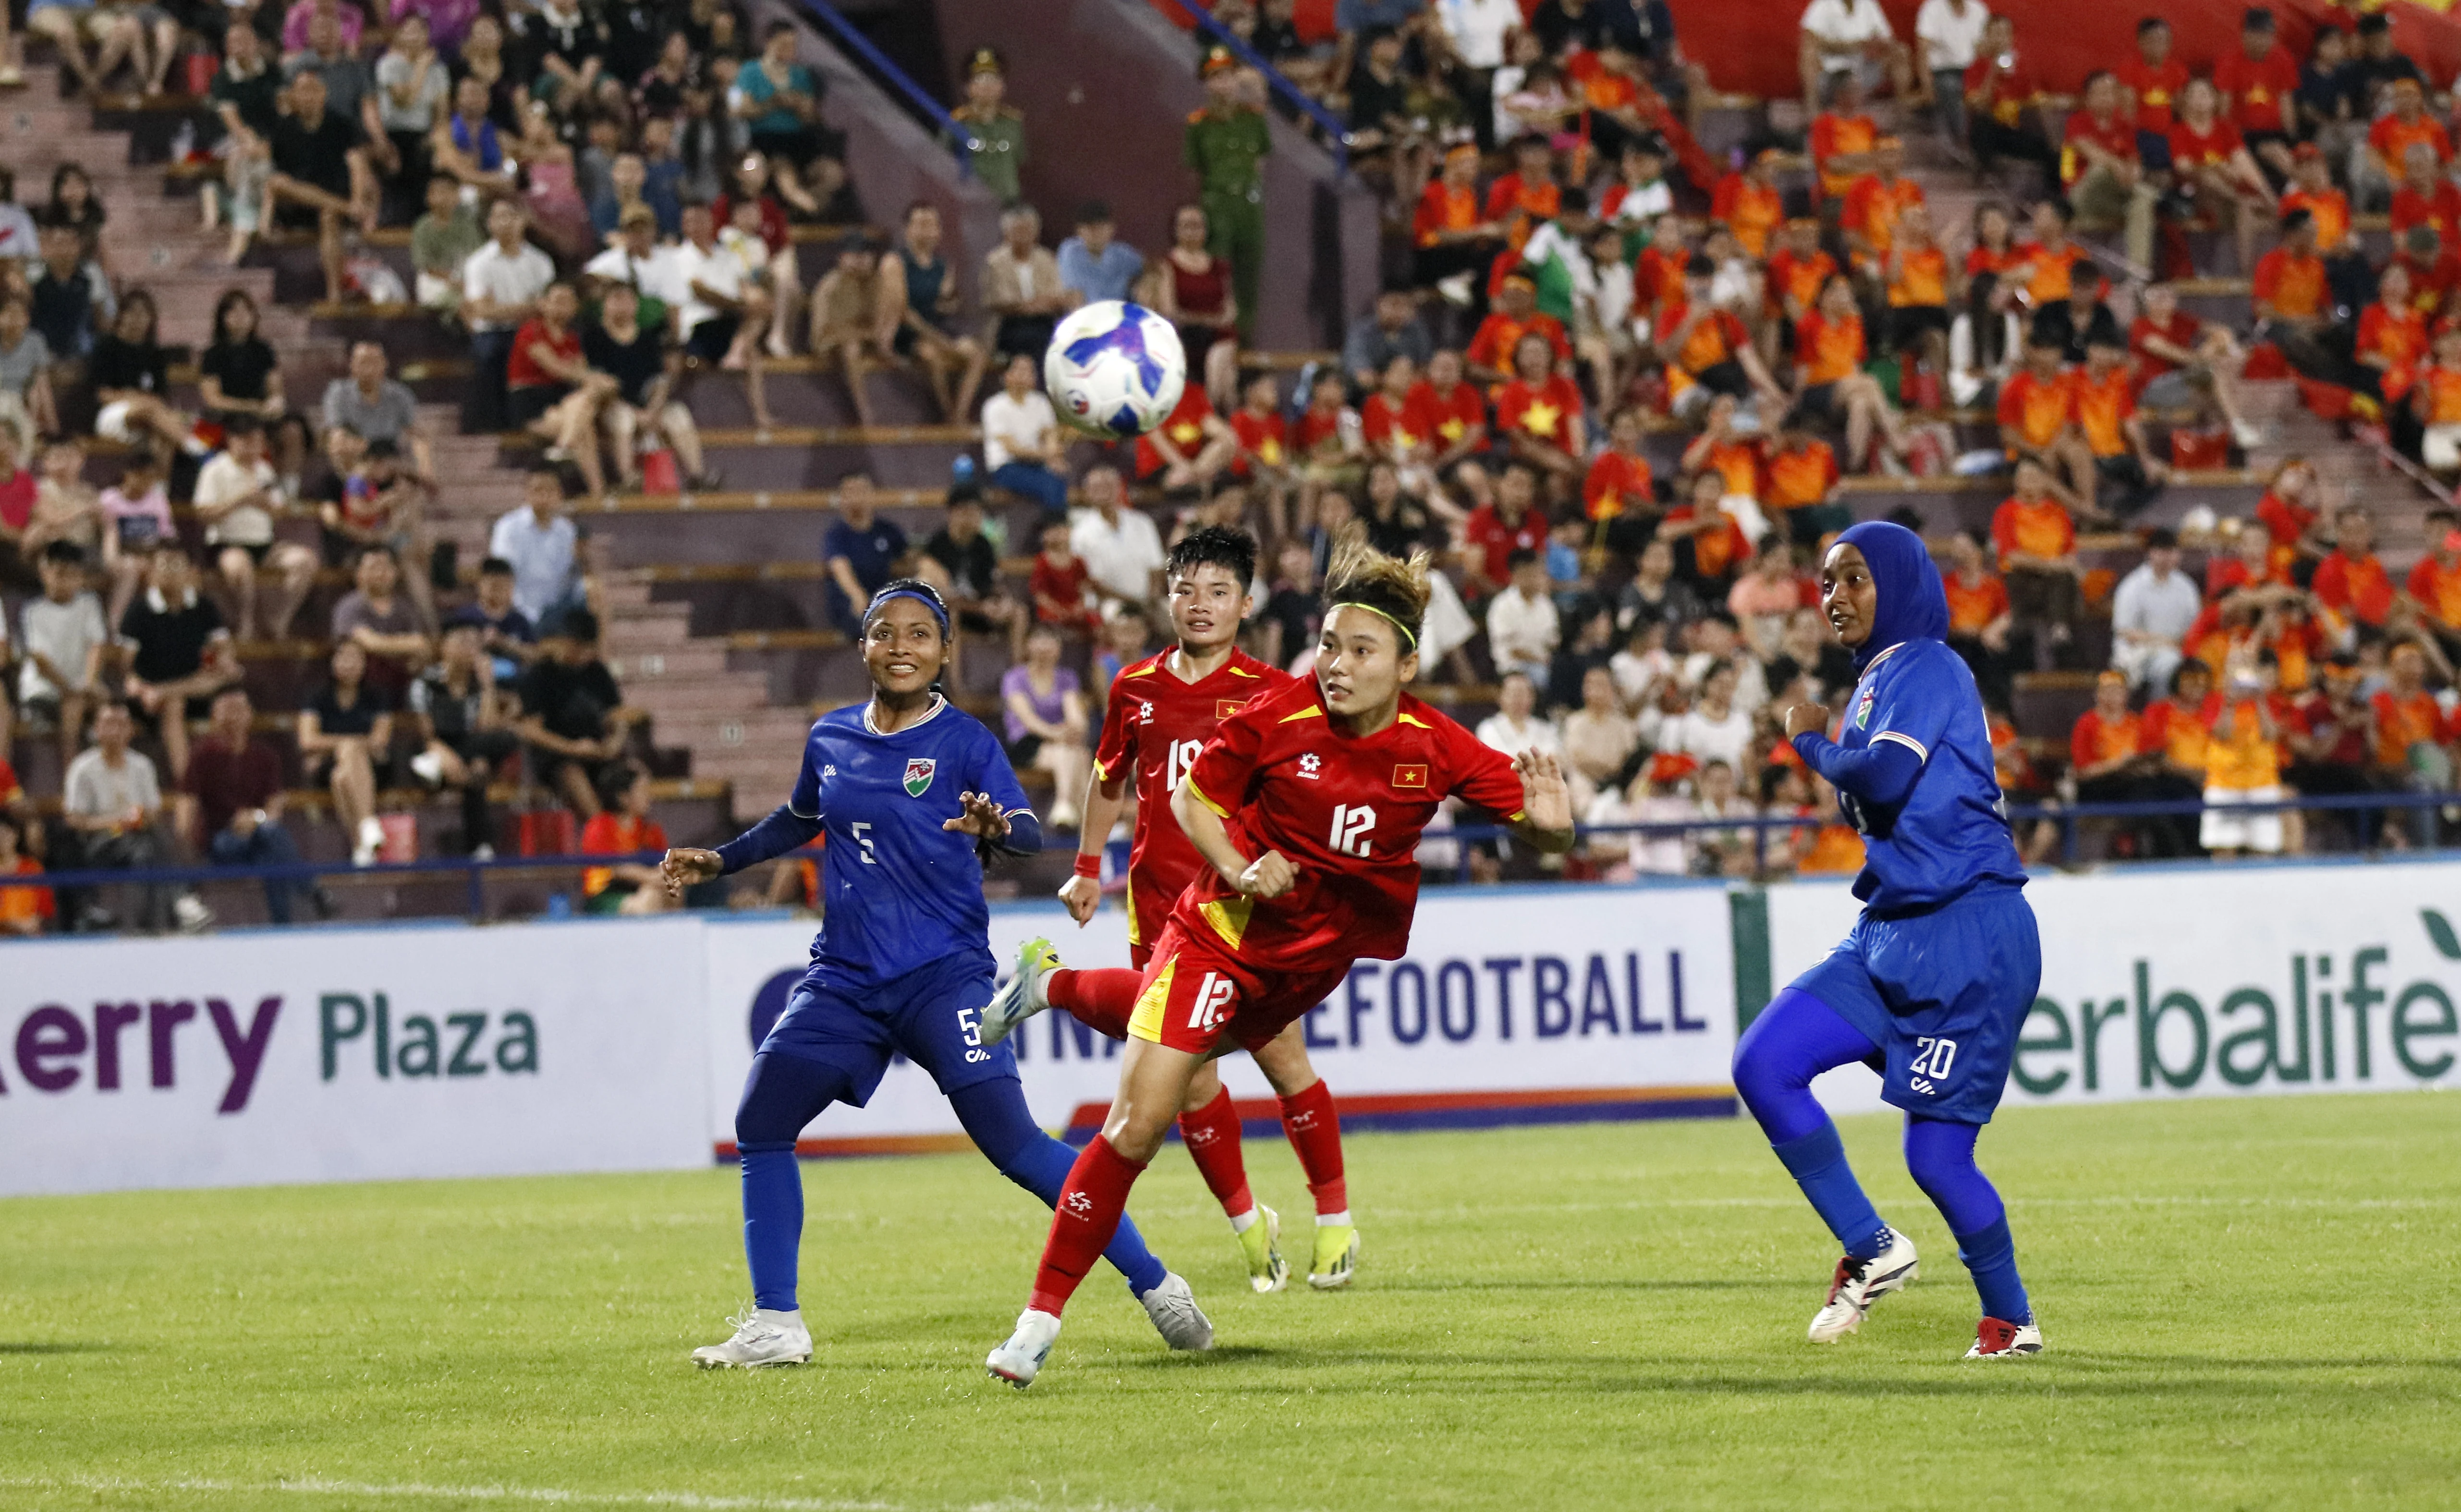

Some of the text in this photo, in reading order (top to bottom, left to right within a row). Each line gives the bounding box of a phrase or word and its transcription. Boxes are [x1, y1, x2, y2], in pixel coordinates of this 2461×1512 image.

[852, 822, 876, 864] 5
[1329, 804, 1376, 858] 12
[957, 1008, 982, 1046] 5
[1188, 972, 1234, 1033] 12
[2011, 944, 2458, 1096] erbalife
[0, 991, 540, 1114] erry Plaza
[1910, 1036, 1957, 1080] 20
